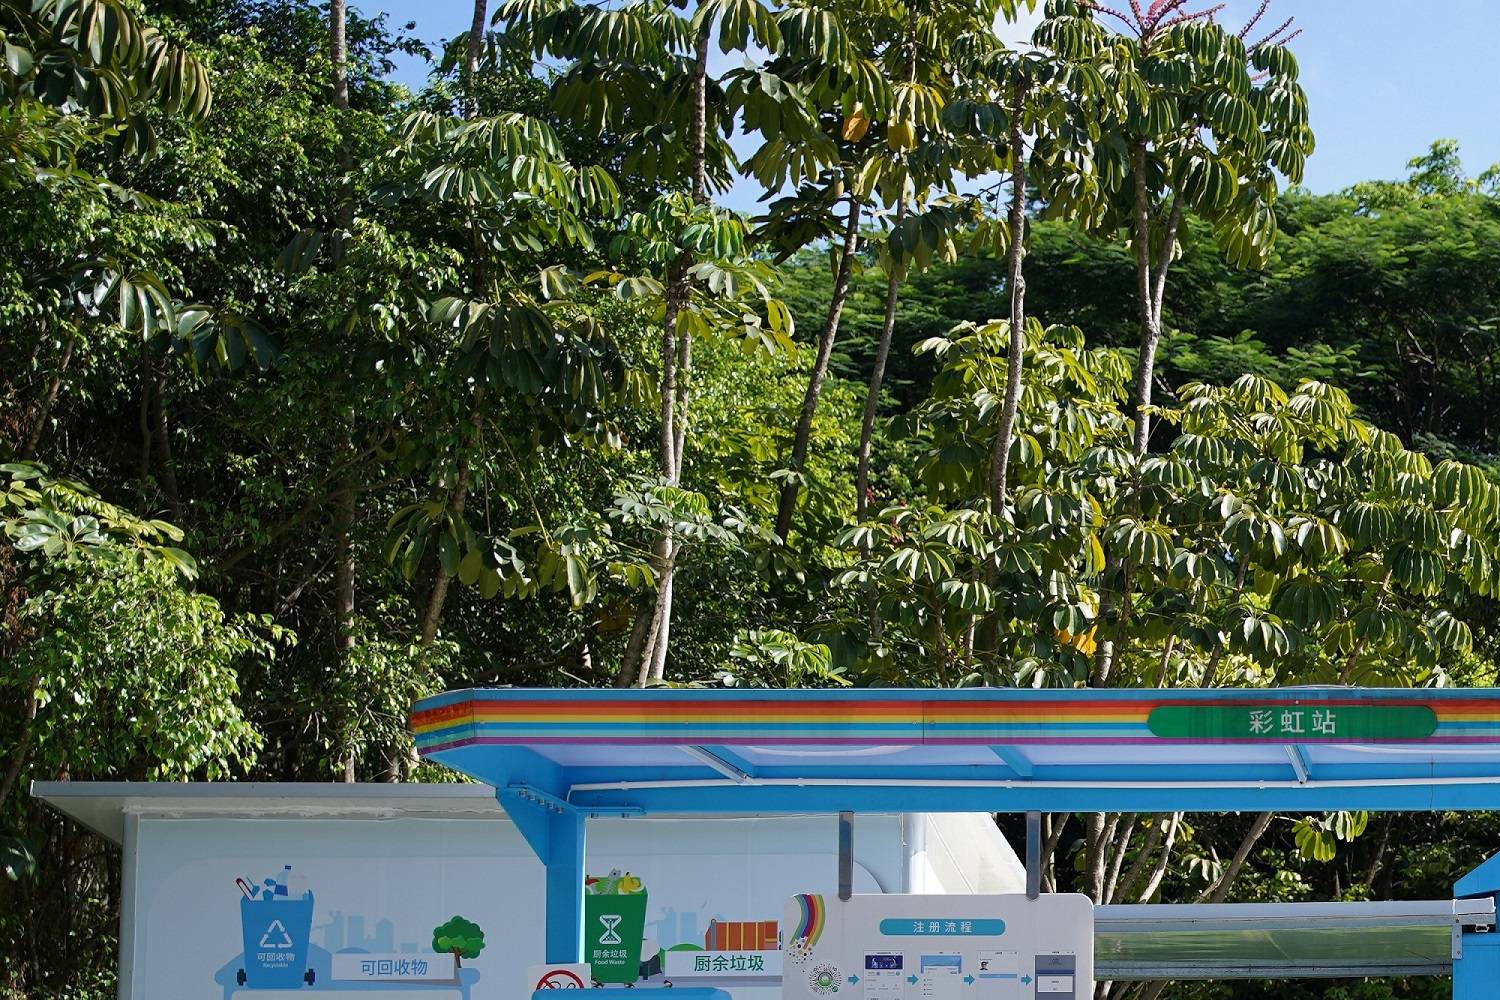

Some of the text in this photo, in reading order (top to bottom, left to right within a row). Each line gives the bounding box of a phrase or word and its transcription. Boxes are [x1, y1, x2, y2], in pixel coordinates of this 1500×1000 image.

[1249, 710, 1336, 735] 彩虹站
[912, 921, 973, 933] 注册流程
[257, 952, 295, 962] 可回收物
[592, 949, 627, 959] 厨余垃圾
[360, 959, 428, 976] 可回收物
[694, 955, 764, 972] 厨余垃圾
